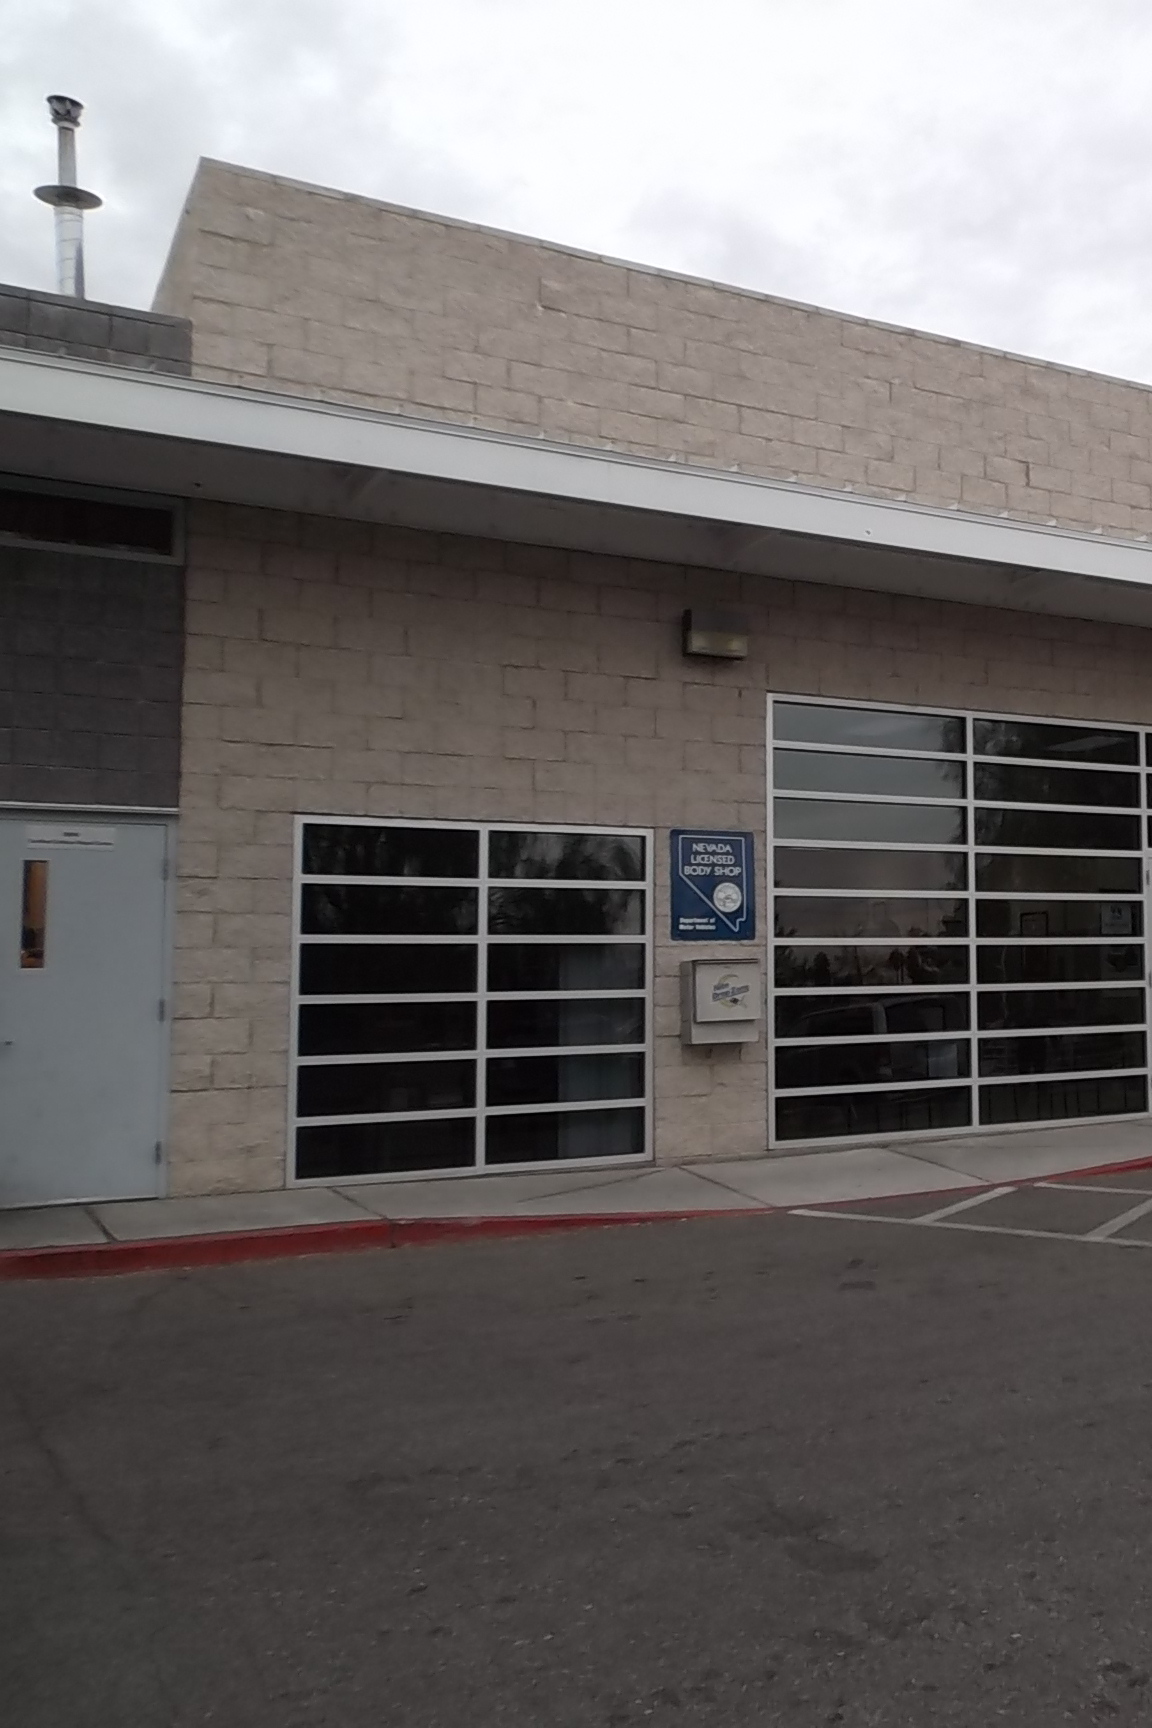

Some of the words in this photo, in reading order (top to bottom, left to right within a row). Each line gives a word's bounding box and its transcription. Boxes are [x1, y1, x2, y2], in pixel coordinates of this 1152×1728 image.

[692, 843, 732, 853] NEVADA
[691, 854, 735, 864] LICENSED
[684, 866, 712, 875] BODY
[714, 866, 742, 876] SHOP
